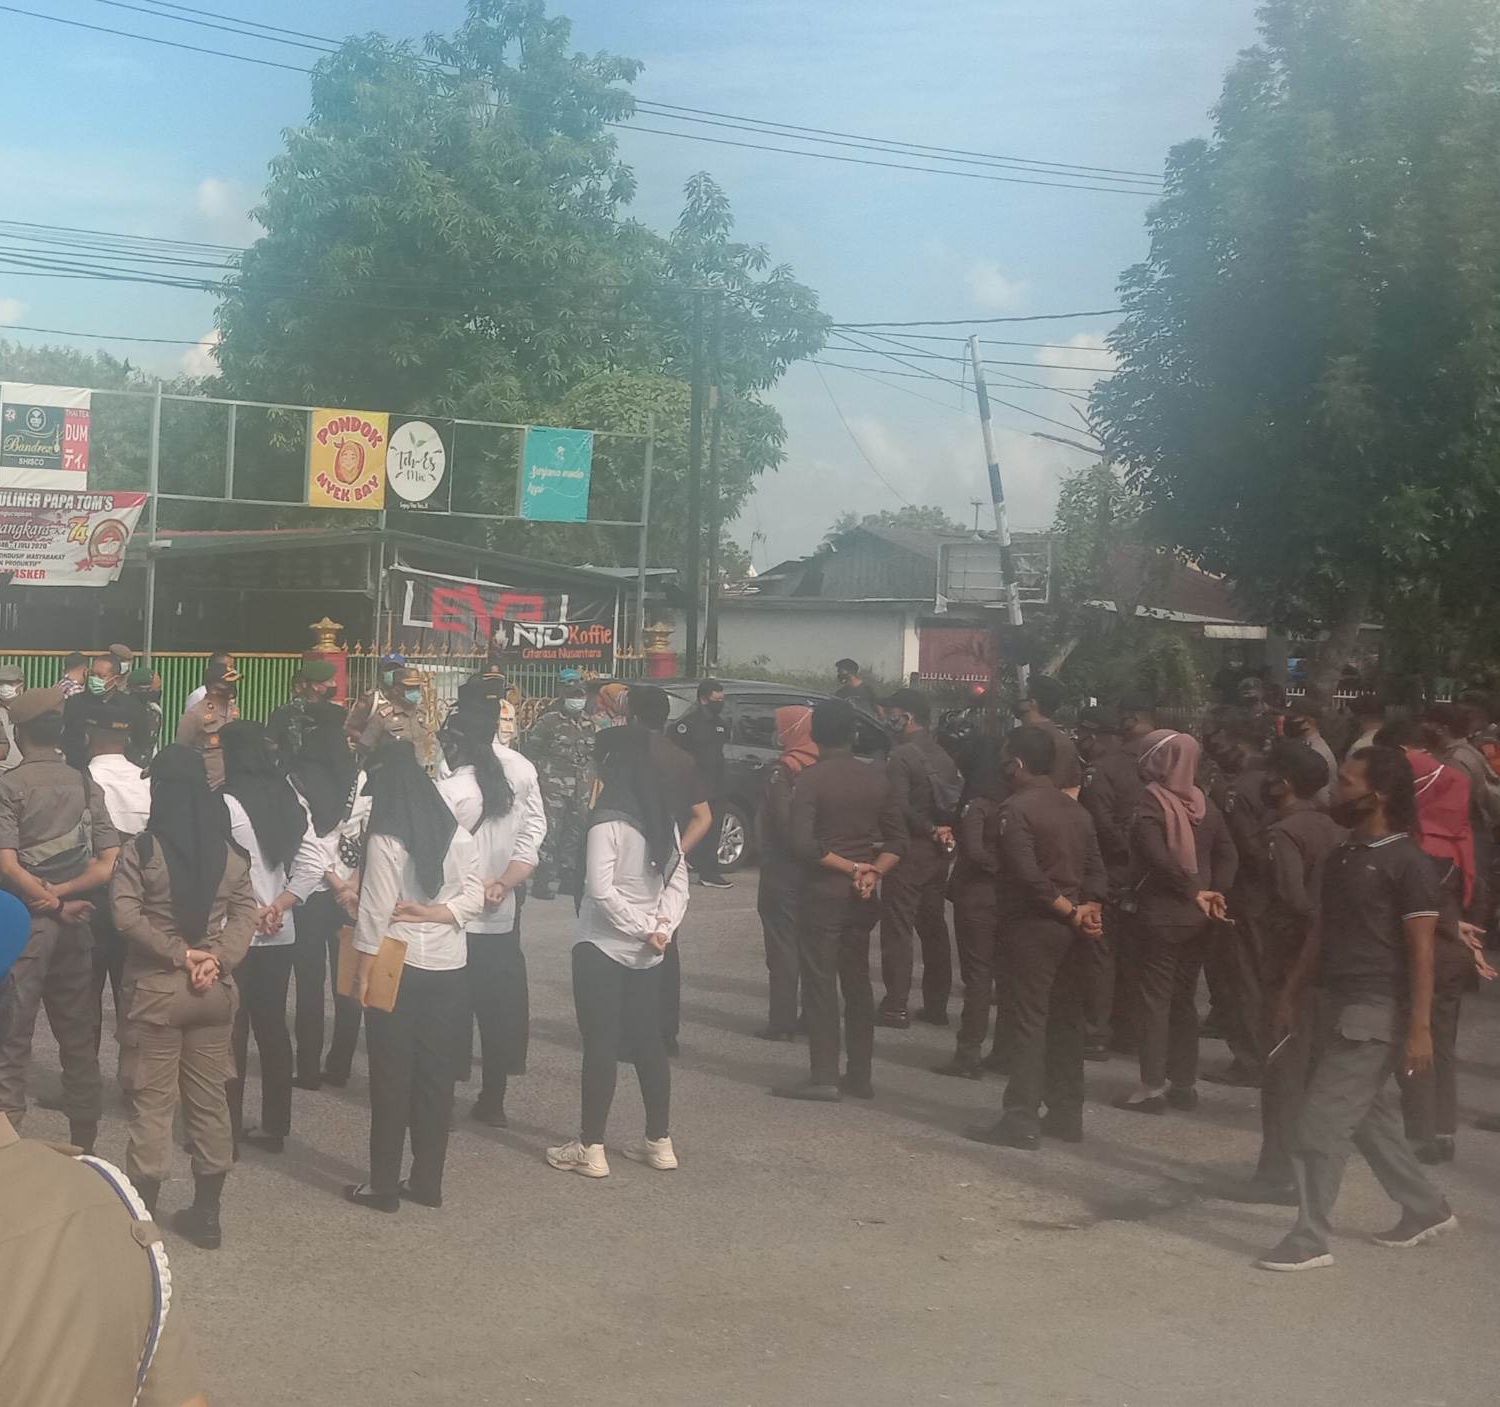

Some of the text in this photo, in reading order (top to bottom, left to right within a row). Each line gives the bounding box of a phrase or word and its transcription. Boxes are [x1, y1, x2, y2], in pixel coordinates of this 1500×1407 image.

[79, 410, 90, 418] TEA
[66, 424, 88, 442] DUM
[316, 416, 383, 448] PONDOK
[18, 458, 44, 466] SHISCO
[316, 473, 379, 502] NYEK BAY
[43, 494, 74, 510] PAPA
[76, 495, 114, 512] TOM'S
[67, 516, 90, 545] 74
[512, 622, 612, 649] NTD Koffie
[522, 648, 602, 659] Citarasa Nusantara
